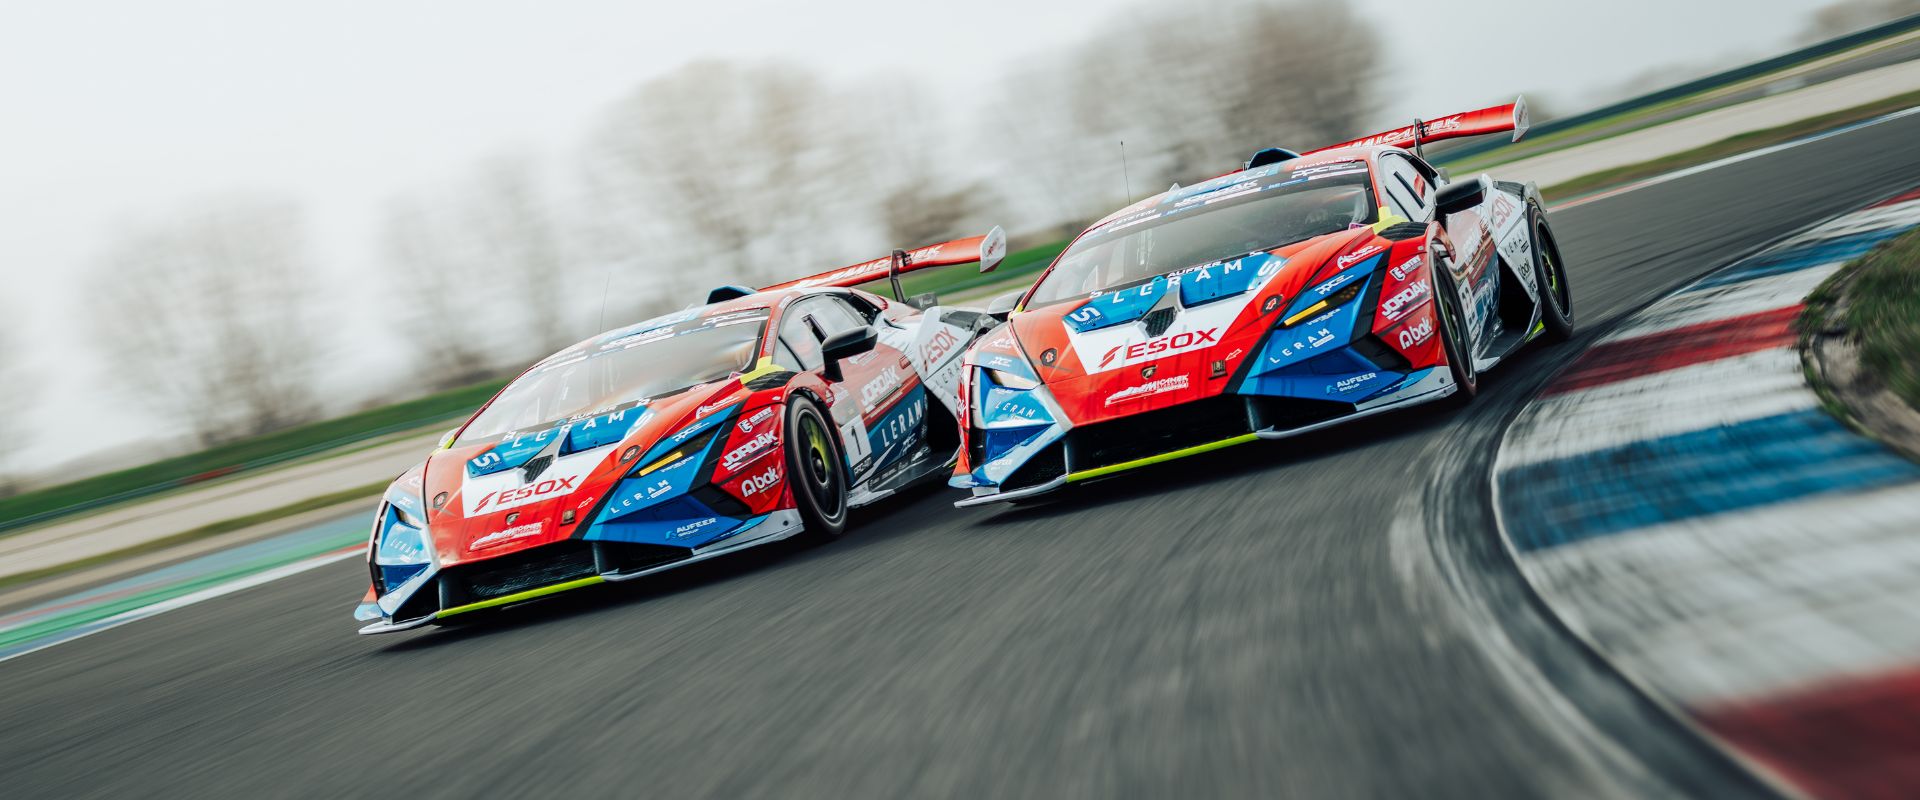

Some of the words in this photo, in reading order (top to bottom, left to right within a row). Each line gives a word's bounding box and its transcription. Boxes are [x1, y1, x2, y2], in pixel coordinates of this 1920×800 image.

[1112, 259, 1242, 304] LERAM
[1125, 327, 1219, 360] ESOX
[1270, 328, 1330, 364] LERAM
[1336, 372, 1377, 388] AUFEER
[881, 399, 923, 447] LERAM
[994, 400, 1036, 418] LERAM
[512, 409, 626, 448] LERAM
[851, 425, 862, 456] 1
[496, 475, 578, 506] ESOX
[610, 479, 669, 514] LERAM
[677, 517, 717, 534] AUFEER
